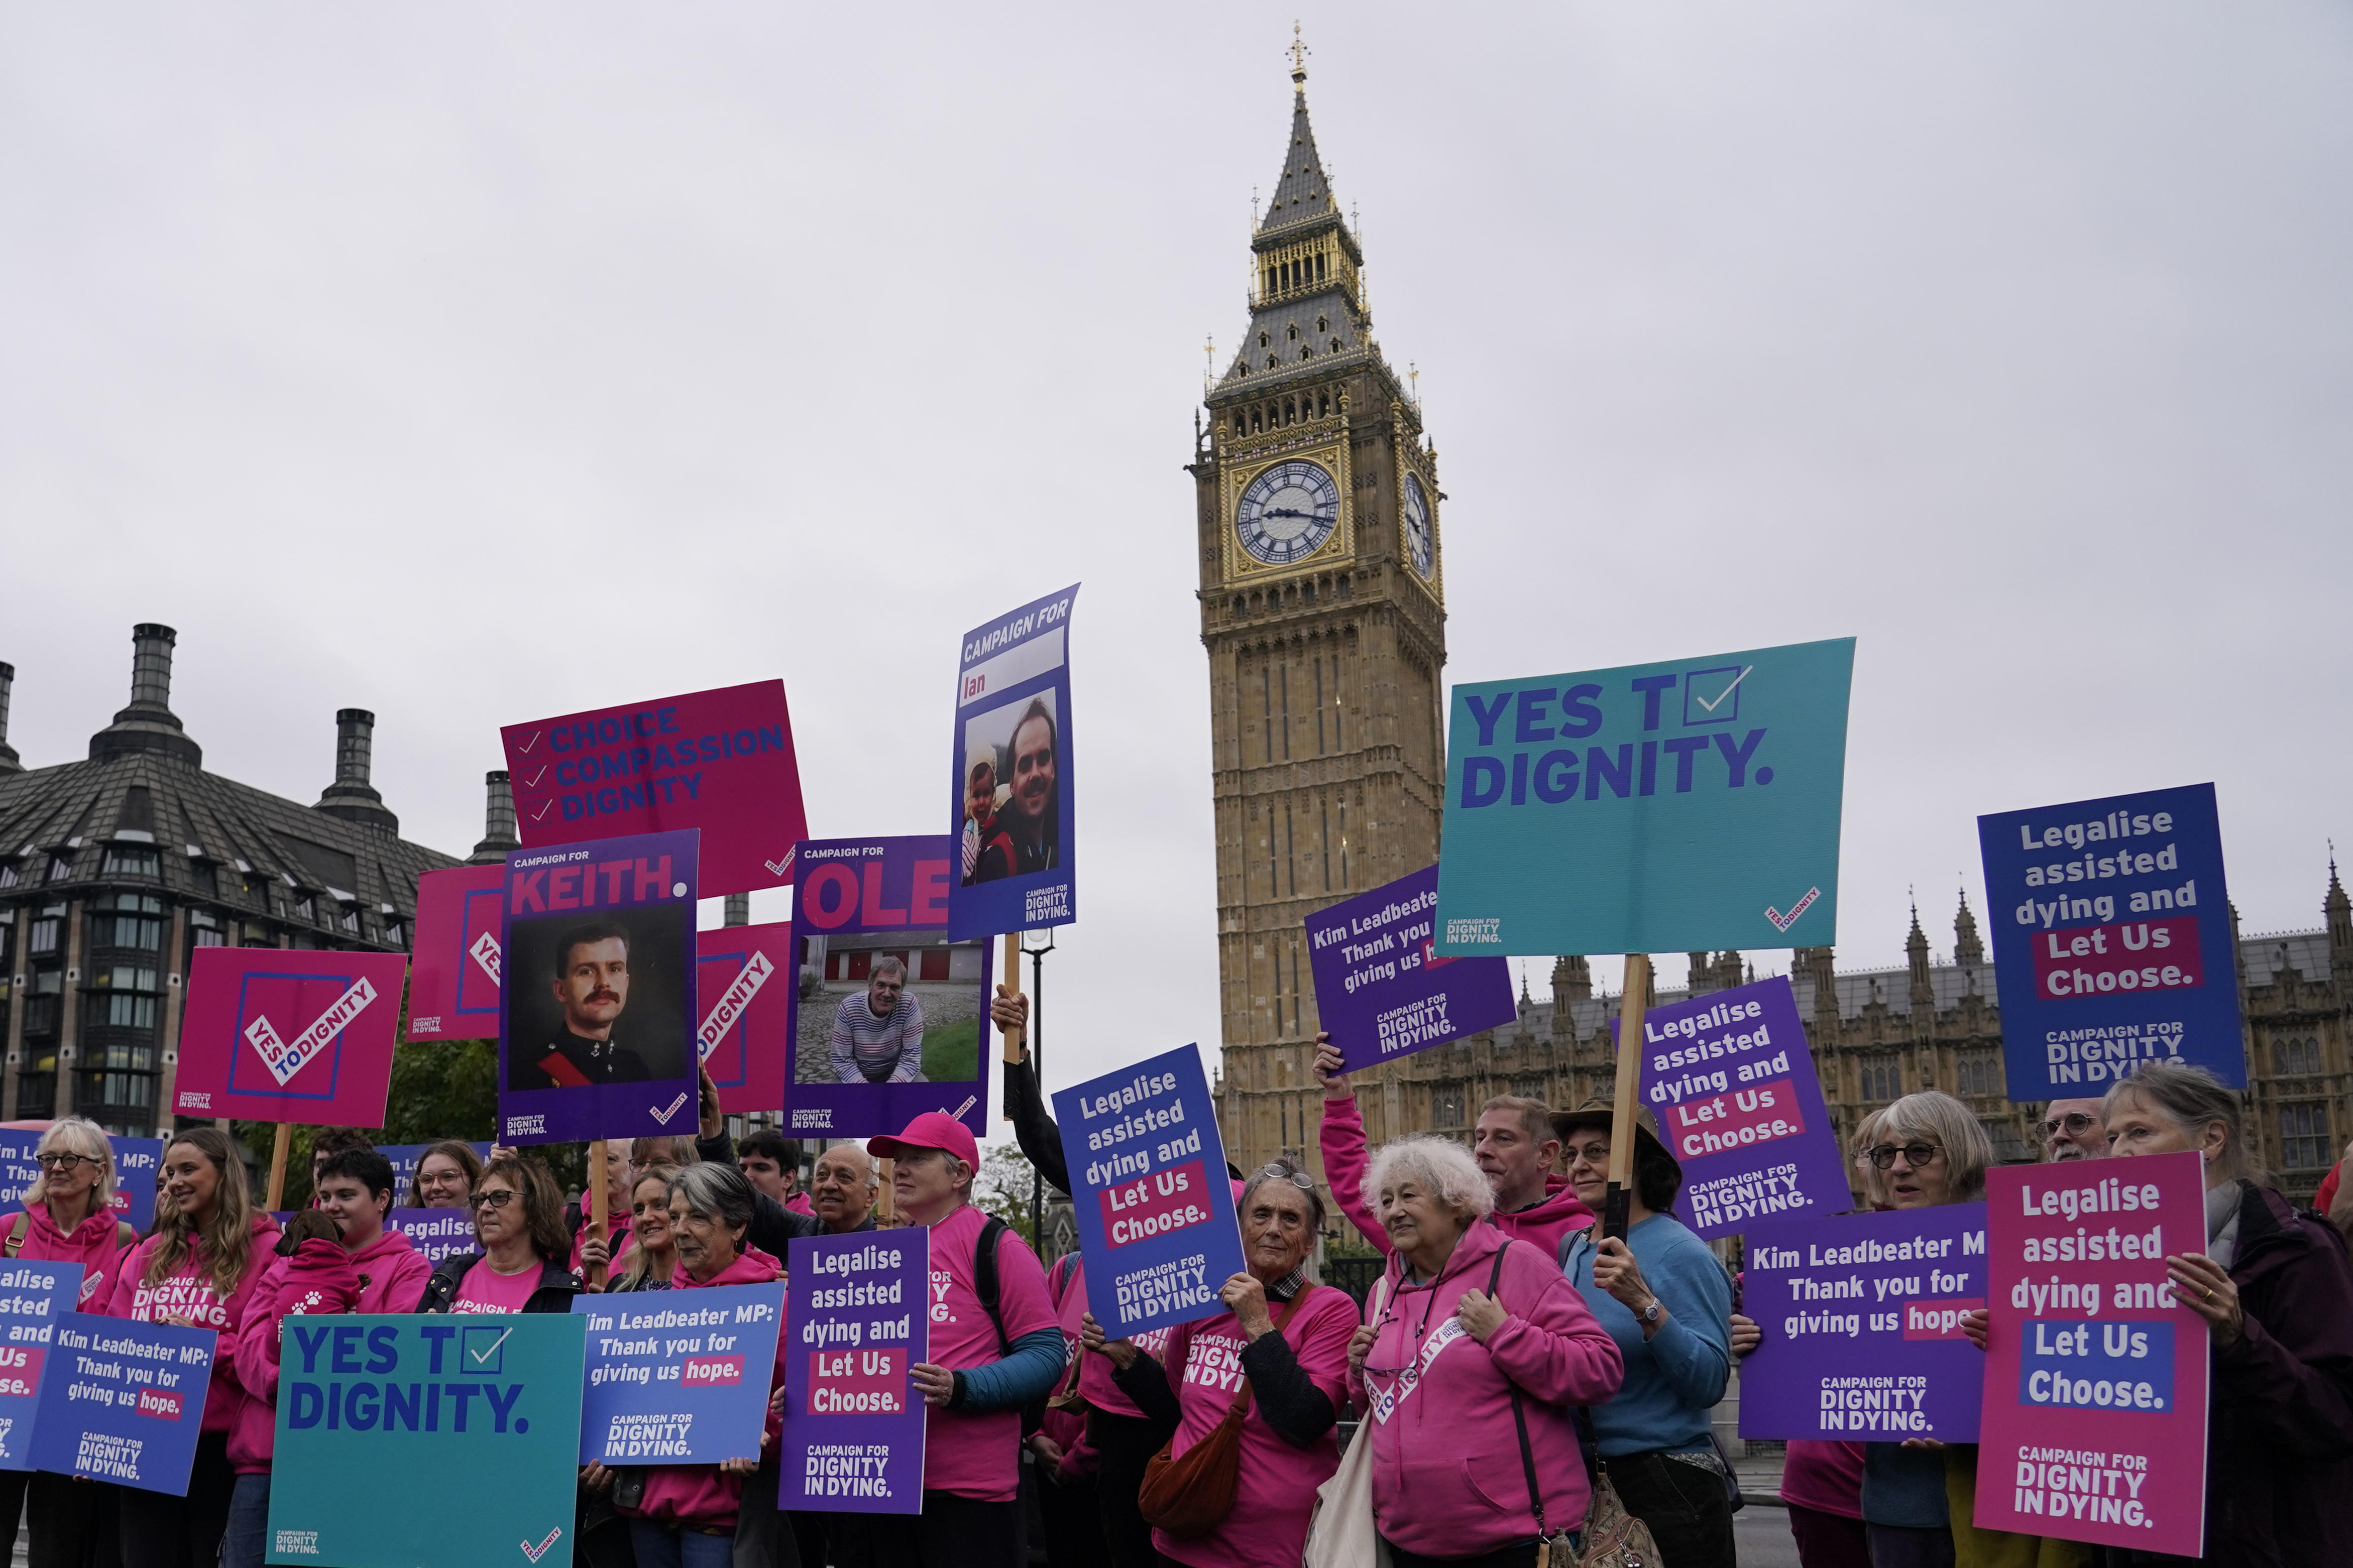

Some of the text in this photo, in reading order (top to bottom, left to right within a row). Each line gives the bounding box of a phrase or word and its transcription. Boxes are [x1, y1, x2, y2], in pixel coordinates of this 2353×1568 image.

[965, 598, 1069, 662] CAMPAIGN FOR
[964, 673, 985, 700] Ian
[549, 706, 680, 753] CHOICE
[1464, 683, 1604, 746] YES
[555, 724, 784, 787] COMPASSION
[1460, 728, 1774, 809] DIGNITY.
[561, 772, 703, 822] DIGNITY
[2021, 810, 2173, 850] Legalise
[514, 851, 589, 868] CAMPAIGN FOR
[805, 847, 883, 859] CAMPAIGN FOR
[2026, 843, 2177, 886] assisted
[510, 855, 687, 915] KEITH.
[803, 860, 950, 928] OLE
[1026, 884, 1067, 898] CAMPAIGN FOR
[1026, 892, 1067, 910] DIGNITY
[1026, 904, 1070, 922] IN DYING.
[2015, 879, 2196, 928] dying and
[1314, 927, 1347, 949] Kim
[1341, 933, 1394, 964] Thank
[1398, 921, 1430, 948] you
[1446, 933, 1502, 943] IN DYING.
[1447, 924, 1499, 934] DIGNITY
[2048, 924, 2170, 958] Let Us
[1345, 961, 1395, 994] giving
[1400, 952, 1420, 971] us
[2047, 966, 2193, 995] Choose.
[1377, 993, 1446, 1023] CAMPAIGN FOR
[1378, 1002, 1446, 1038] DIGNITY
[1645, 1001, 1761, 1043] Legalise
[253, 1022, 282, 1062] YES
[1381, 1019, 1456, 1053] IN DYING.
[1653, 1024, 1770, 1071] assisted
[2046, 1022, 2183, 1042] CAMPAIGN FOR
[2047, 1034, 2184, 1063] DIGNITY
[1650, 1050, 1789, 1103] dying and
[2049, 1063, 2080, 1083] IN
[1080, 1073, 1176, 1119] Legalise
[1678, 1090, 1774, 1126] Let Us
[1088, 1098, 1184, 1150] assisted
[1683, 1120, 1797, 1155] Choose.
[1086, 1128, 1201, 1185] dying and
[1109, 1171, 1188, 1212] Let Us
[1689, 1163, 1797, 1194] CAMPAIGN FOR
[1691, 1173, 1798, 1212] DIGNITY
[1695, 1191, 1813, 1228] IN DYING.
[2023, 1178, 2159, 1222] Legalise
[1112, 1205, 1206, 1243] Choose.
[1753, 1236, 1952, 1269] Kim Leadbeater
[2024, 1225, 2162, 1262] assisted
[813, 1245, 901, 1277] Legalise
[1115, 1254, 1205, 1286] CAMPAIGN FOR
[812, 1279, 901, 1308] assisted
[1117, 1265, 1205, 1305] DIGNITY
[1788, 1269, 1968, 1301] Thank you for
[2011, 1275, 2099, 1316] dying
[620, 1304, 773, 1330] Leadbeater MP:
[1119, 1285, 1217, 1323] IN DYING.
[803, 1313, 909, 1348] dying and
[1785, 1309, 1898, 1339] giving us
[2036, 1323, 2148, 1358] Let Us
[58, 1330, 208, 1366] Kim Leadbeater MP:
[293, 1325, 399, 1374] YES
[600, 1333, 737, 1358] Thank you for
[77, 1356, 180, 1387] Thank you for
[591, 1361, 739, 1386] giving us hope.
[819, 1352, 890, 1376] Let Us
[68, 1381, 179, 1414] giving us hope.
[1822, 1376, 1926, 1388] CAMPAIGN FOR
[2029, 1370, 2164, 1409] Choose.
[288, 1382, 529, 1434] DIGNITY.
[814, 1387, 900, 1412] Choose.
[1821, 1389, 1926, 1409] DIGNITY
[608, 1423, 691, 1440] DIGNITY
[612, 1414, 693, 1424] CAMPAIGN FOR
[1820, 1411, 1933, 1431] IN DYING.
[79, 1440, 141, 1464] DIGNITY
[82, 1431, 143, 1450] CAMPAIGN FOR
[605, 1440, 692, 1456] IN DYING.
[808, 1445, 889, 1456] CAMPAIGN FOR
[75, 1455, 140, 1480] IN DYING.
[806, 1457, 888, 1477] DIGNITY
[2019, 1446, 2147, 1471] CAMPAIGN FOR
[805, 1477, 891, 1497] IN DYING.
[2016, 1462, 2146, 1498] DIGNITY
[2015, 1488, 2153, 1528] IN DYING.
[276, 1544, 319, 1554] IN DYING.
[277, 1535, 317, 1545] DIGNITY
